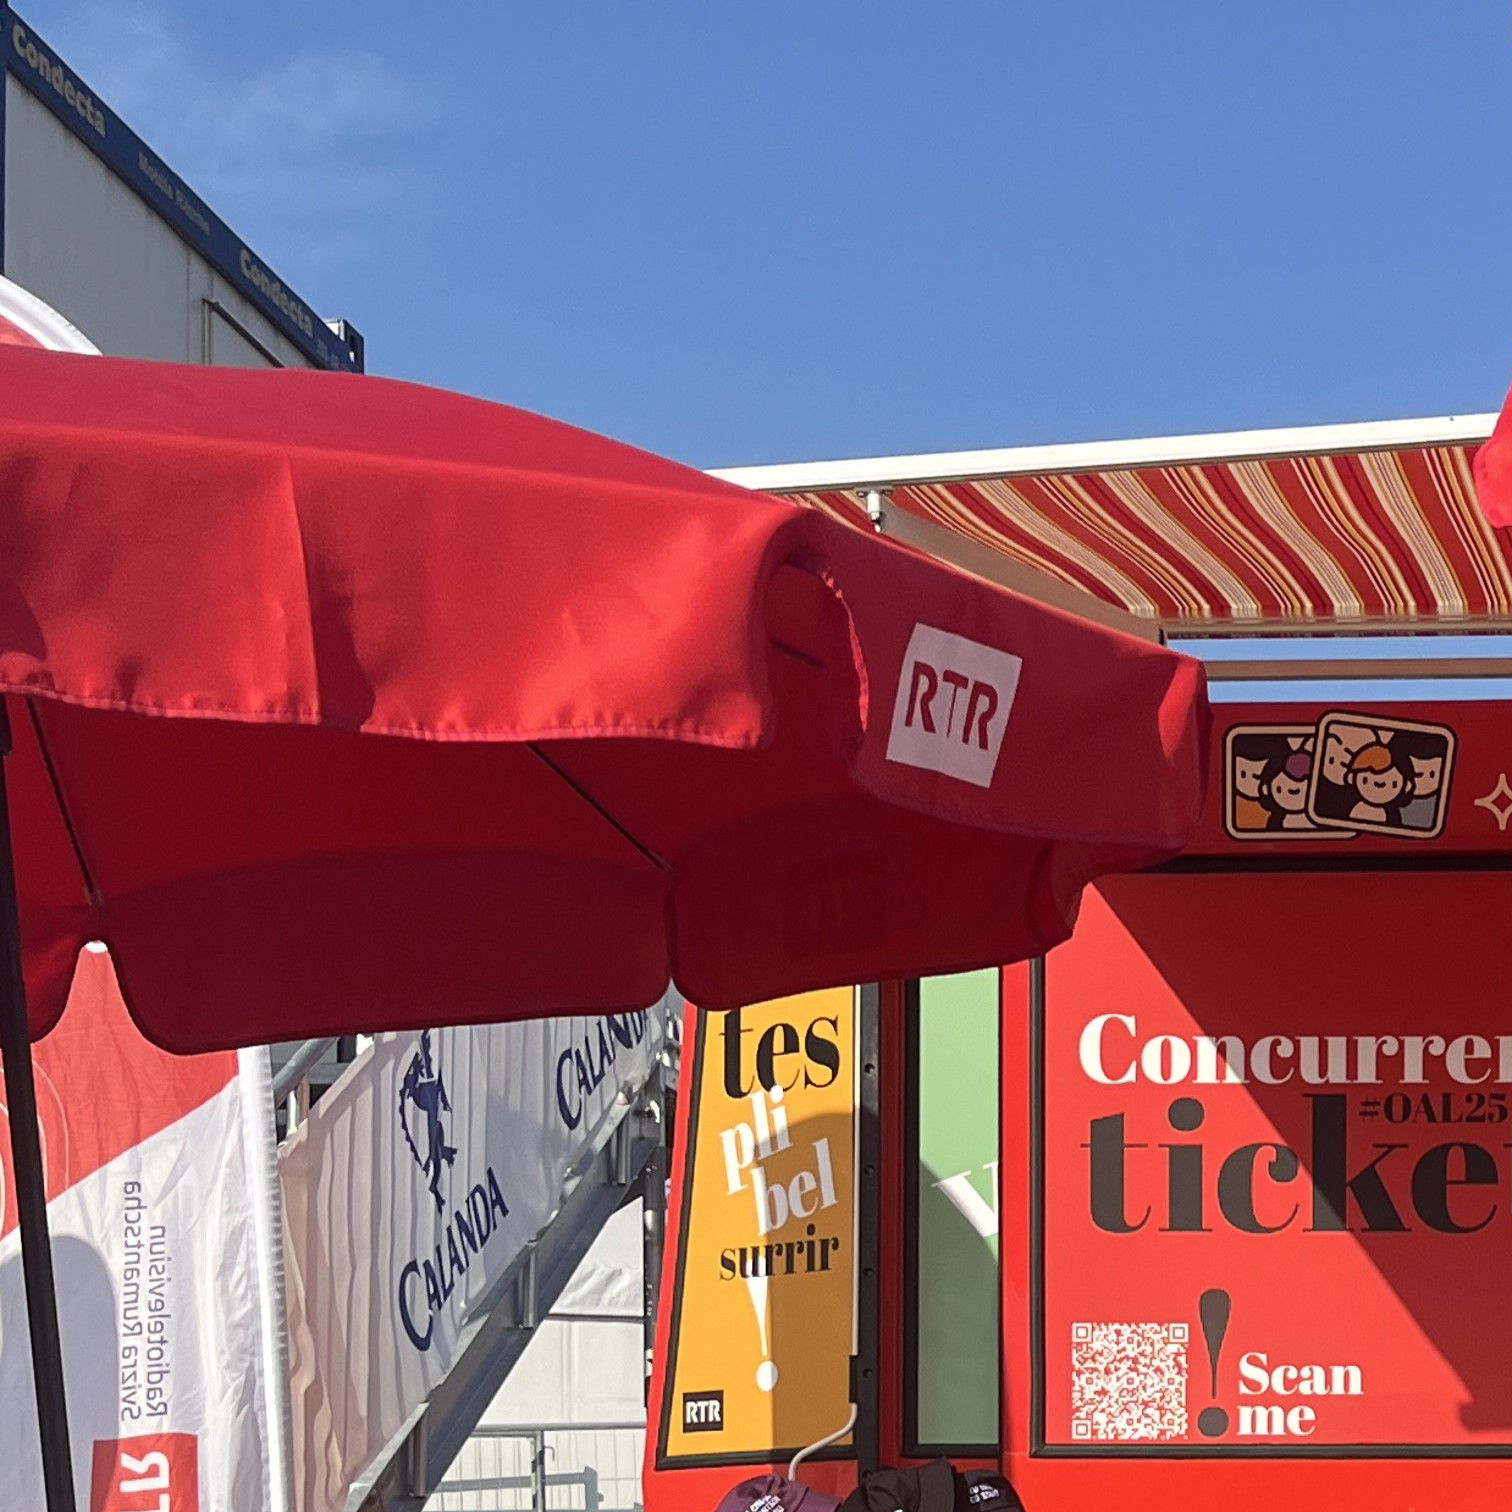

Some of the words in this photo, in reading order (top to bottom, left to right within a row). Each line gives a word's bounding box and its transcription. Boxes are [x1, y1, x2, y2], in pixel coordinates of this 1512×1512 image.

[12, 24, 106, 138] Condecta
[240, 249, 313, 339] Condecta
[904, 660, 999, 750] RTR
[557, 1008, 648, 1131] CALAND
[719, 1007, 841, 1100] tes
[718, 1084, 795, 1197] pli
[1358, 1091, 1509, 1126] #OAL25
[749, 1136, 840, 1238] bel
[399, 1166, 510, 1352] CALANDA
[719, 1223, 840, 1282] surrir
[684, 1401, 722, 1425] RTR
[1236, 1401, 1317, 1437] me
[1237, 1352, 1365, 1396] Scan
